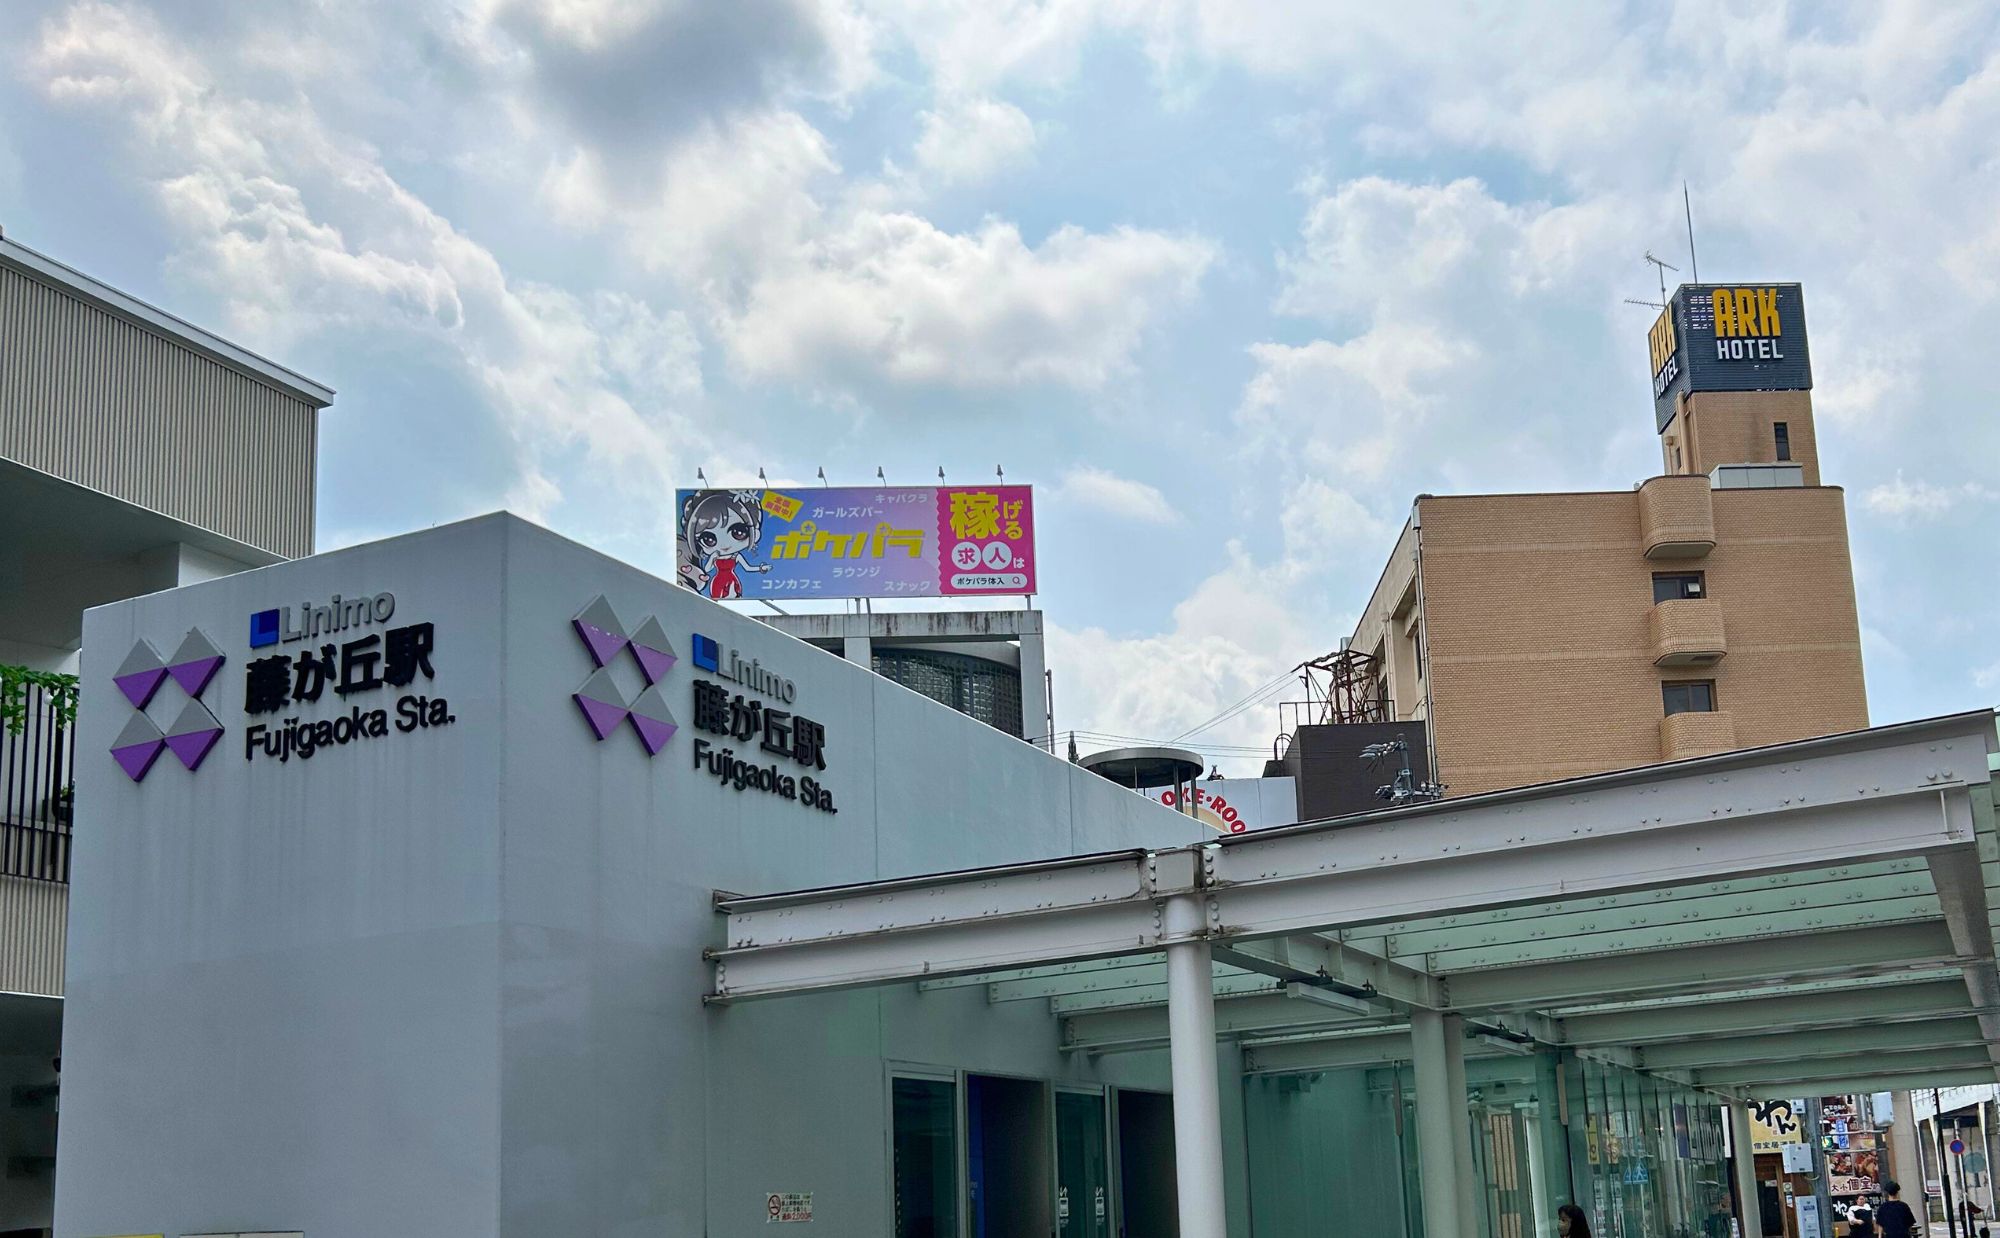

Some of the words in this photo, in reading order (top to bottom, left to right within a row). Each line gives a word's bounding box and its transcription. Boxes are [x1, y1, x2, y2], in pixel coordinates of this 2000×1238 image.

[1712, 288, 1781, 337] ARK
[1651, 300, 1677, 374] ARK
[1717, 339, 1784, 360] HOTEL
[1655, 355, 1678, 400] HOTEL
[812, 506, 884, 518] ガールズバー
[874, 494, 928, 505] キャバクラ
[770, 520, 926, 560] ポケパラ
[762, 579, 822, 590] コンカフェ
[832, 566, 880, 578] ラウンジ
[884, 580, 930, 592] スナック
[280, 592, 395, 643] Linimo
[244, 621, 436, 715] 藤が丘駅
[717, 643, 797, 704] Linimo
[245, 706, 389, 762] Fujigaoka
[395, 694, 456, 733] Sta.
[693, 679, 827, 771] 藤が丘駅
[694, 738, 797, 801] Fujigaoka
[801, 776, 838, 815] Sta.
